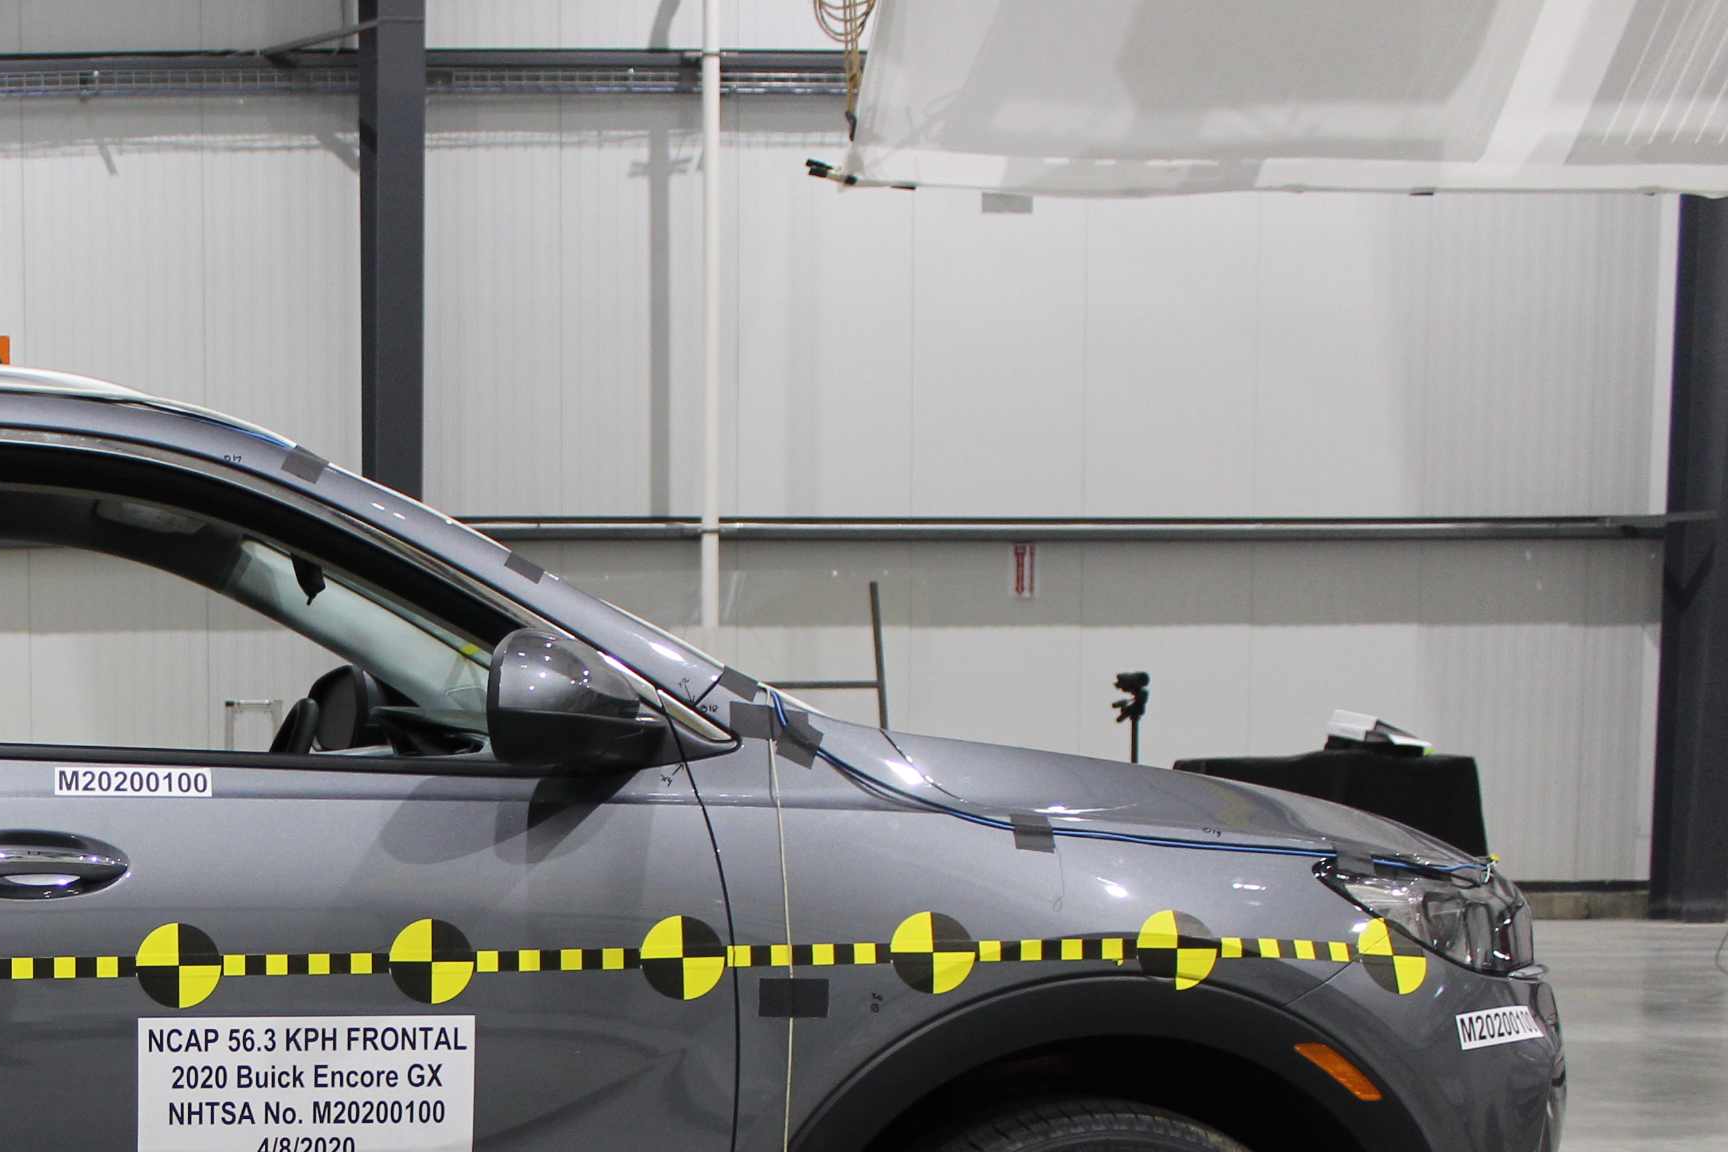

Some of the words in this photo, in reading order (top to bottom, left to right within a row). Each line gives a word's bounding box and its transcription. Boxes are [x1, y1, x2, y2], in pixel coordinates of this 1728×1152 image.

[58, 770, 208, 793] M20200100
[147, 1028, 220, 1053] NCAP
[227, 1027, 276, 1052] 56.3
[285, 1027, 338, 1051] KPH
[346, 1026, 468, 1051] FRONTAL
[172, 1066, 227, 1089] 2020
[236, 1064, 305, 1089] Buick
[314, 1064, 399, 1088] Encore
[407, 1063, 443, 1087] GX
[168, 1101, 256, 1125] NHTSA
[264, 1101, 303, 1125] No.
[312, 1100, 446, 1124] M20200100
